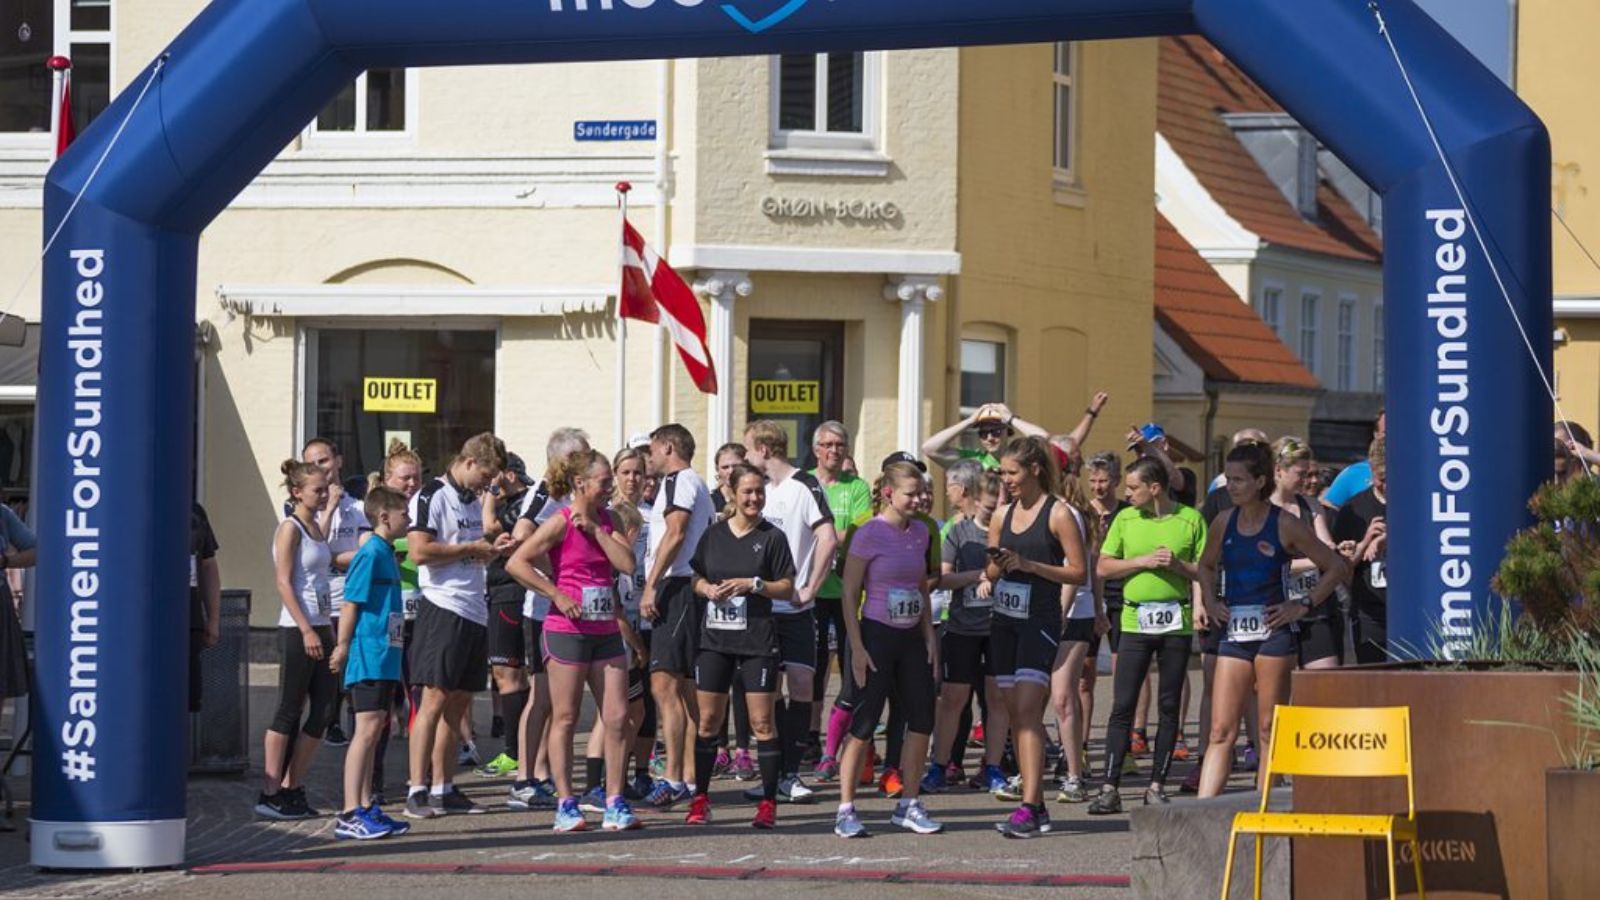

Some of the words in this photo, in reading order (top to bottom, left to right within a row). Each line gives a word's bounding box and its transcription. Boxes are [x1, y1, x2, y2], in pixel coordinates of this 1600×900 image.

[367, 381, 434, 400] OUTLET
[754, 384, 817, 402] OUTLET
[62, 249, 104, 782] #SammenForSundhed
[714, 606, 738, 621] 115
[1147, 610, 1173, 625] 120
[1232, 616, 1259, 632] 140
[1295, 731, 1388, 750] LØKKEN
